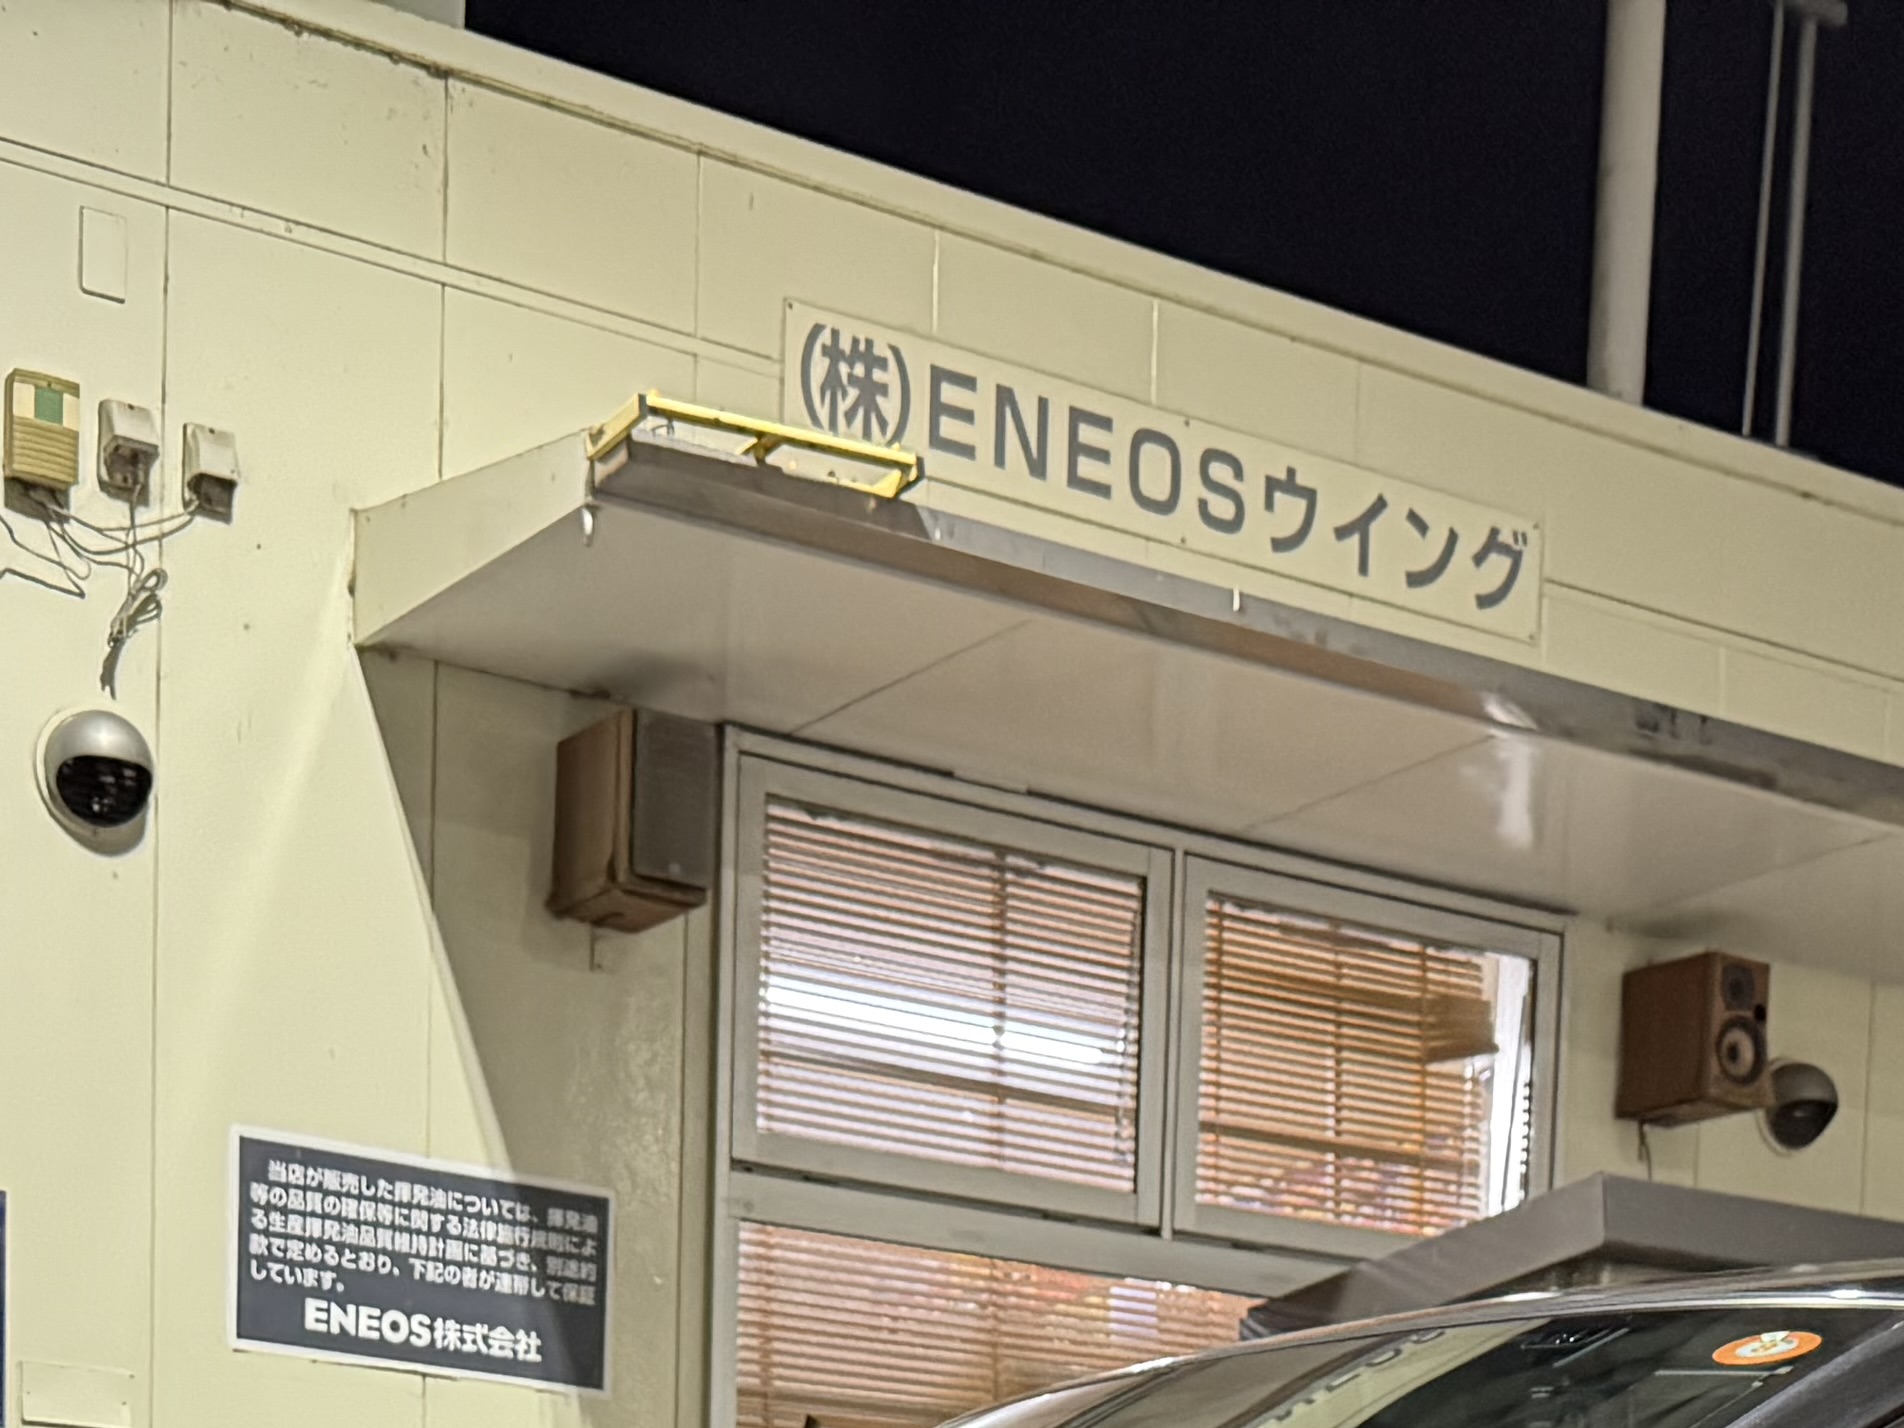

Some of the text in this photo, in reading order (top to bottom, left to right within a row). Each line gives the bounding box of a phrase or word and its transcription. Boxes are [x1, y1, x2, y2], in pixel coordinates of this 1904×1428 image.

[800, 322, 1528, 611] (株)ENEOSウイング
[304, 1296, 543, 1363] ENEOS株式会社
